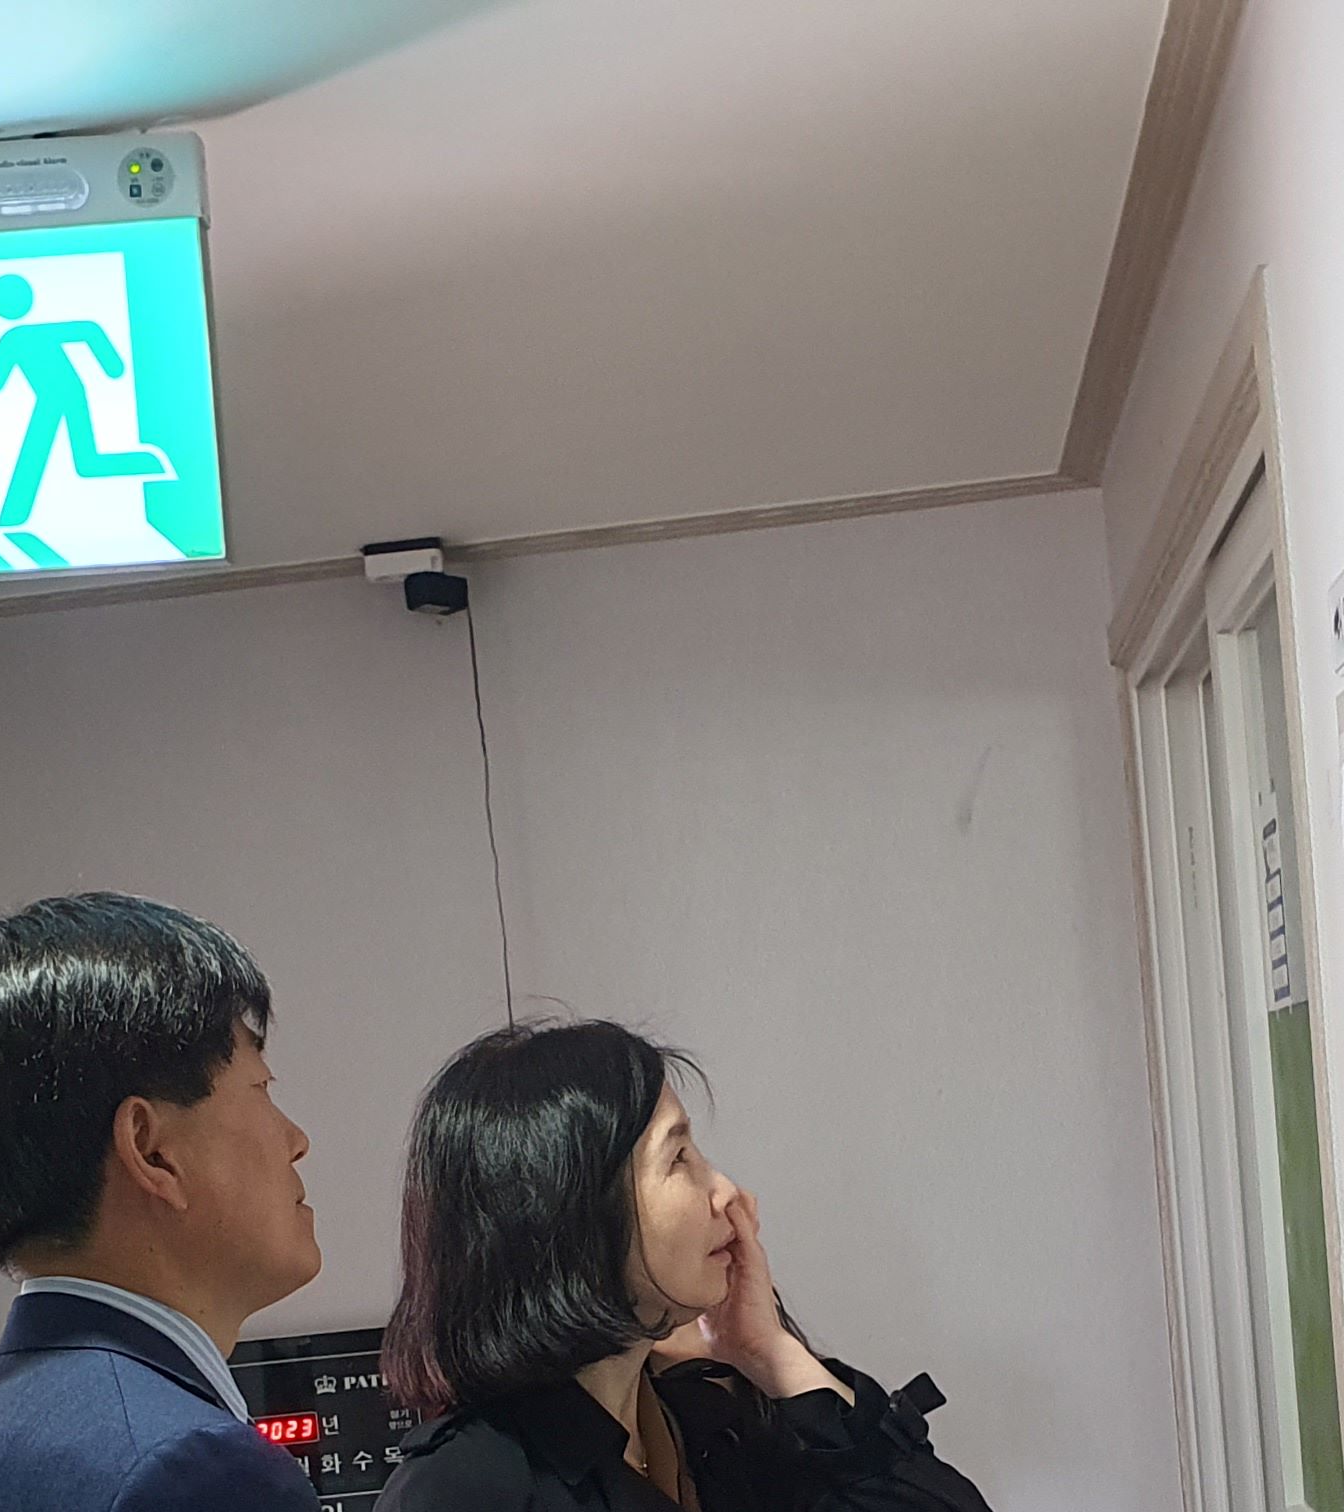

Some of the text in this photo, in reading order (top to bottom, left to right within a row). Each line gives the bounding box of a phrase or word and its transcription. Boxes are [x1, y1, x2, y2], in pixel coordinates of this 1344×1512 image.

[322, 1415, 339, 1436] 년
[321, 1453, 342, 1474] 화
[352, 1451, 373, 1471] 수
